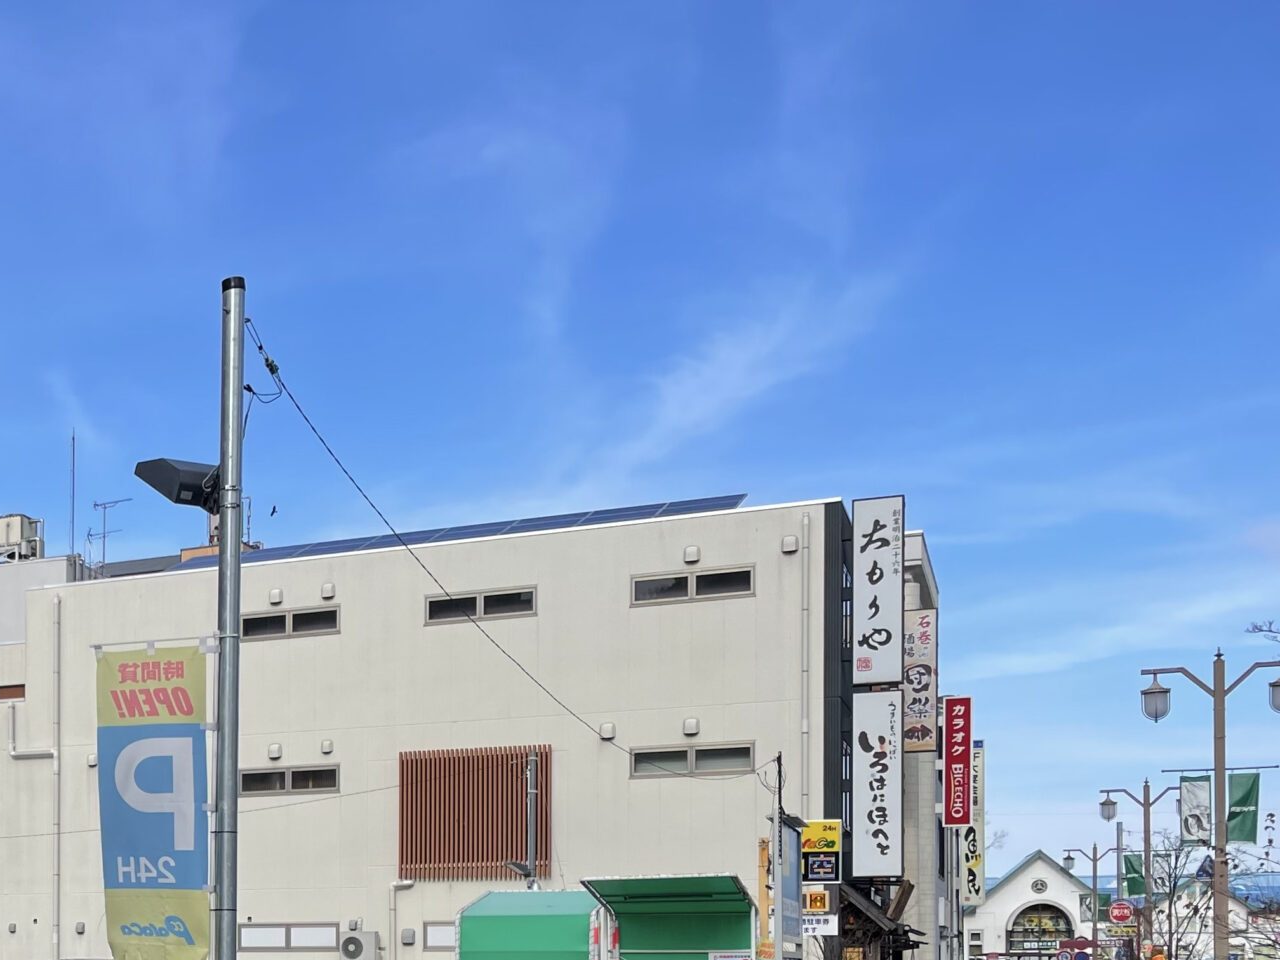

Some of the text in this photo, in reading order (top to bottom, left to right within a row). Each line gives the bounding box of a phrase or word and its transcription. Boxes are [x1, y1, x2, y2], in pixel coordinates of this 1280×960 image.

[951, 704, 966, 757] カラオケ
[857, 730, 891, 856] いろはにほへと
